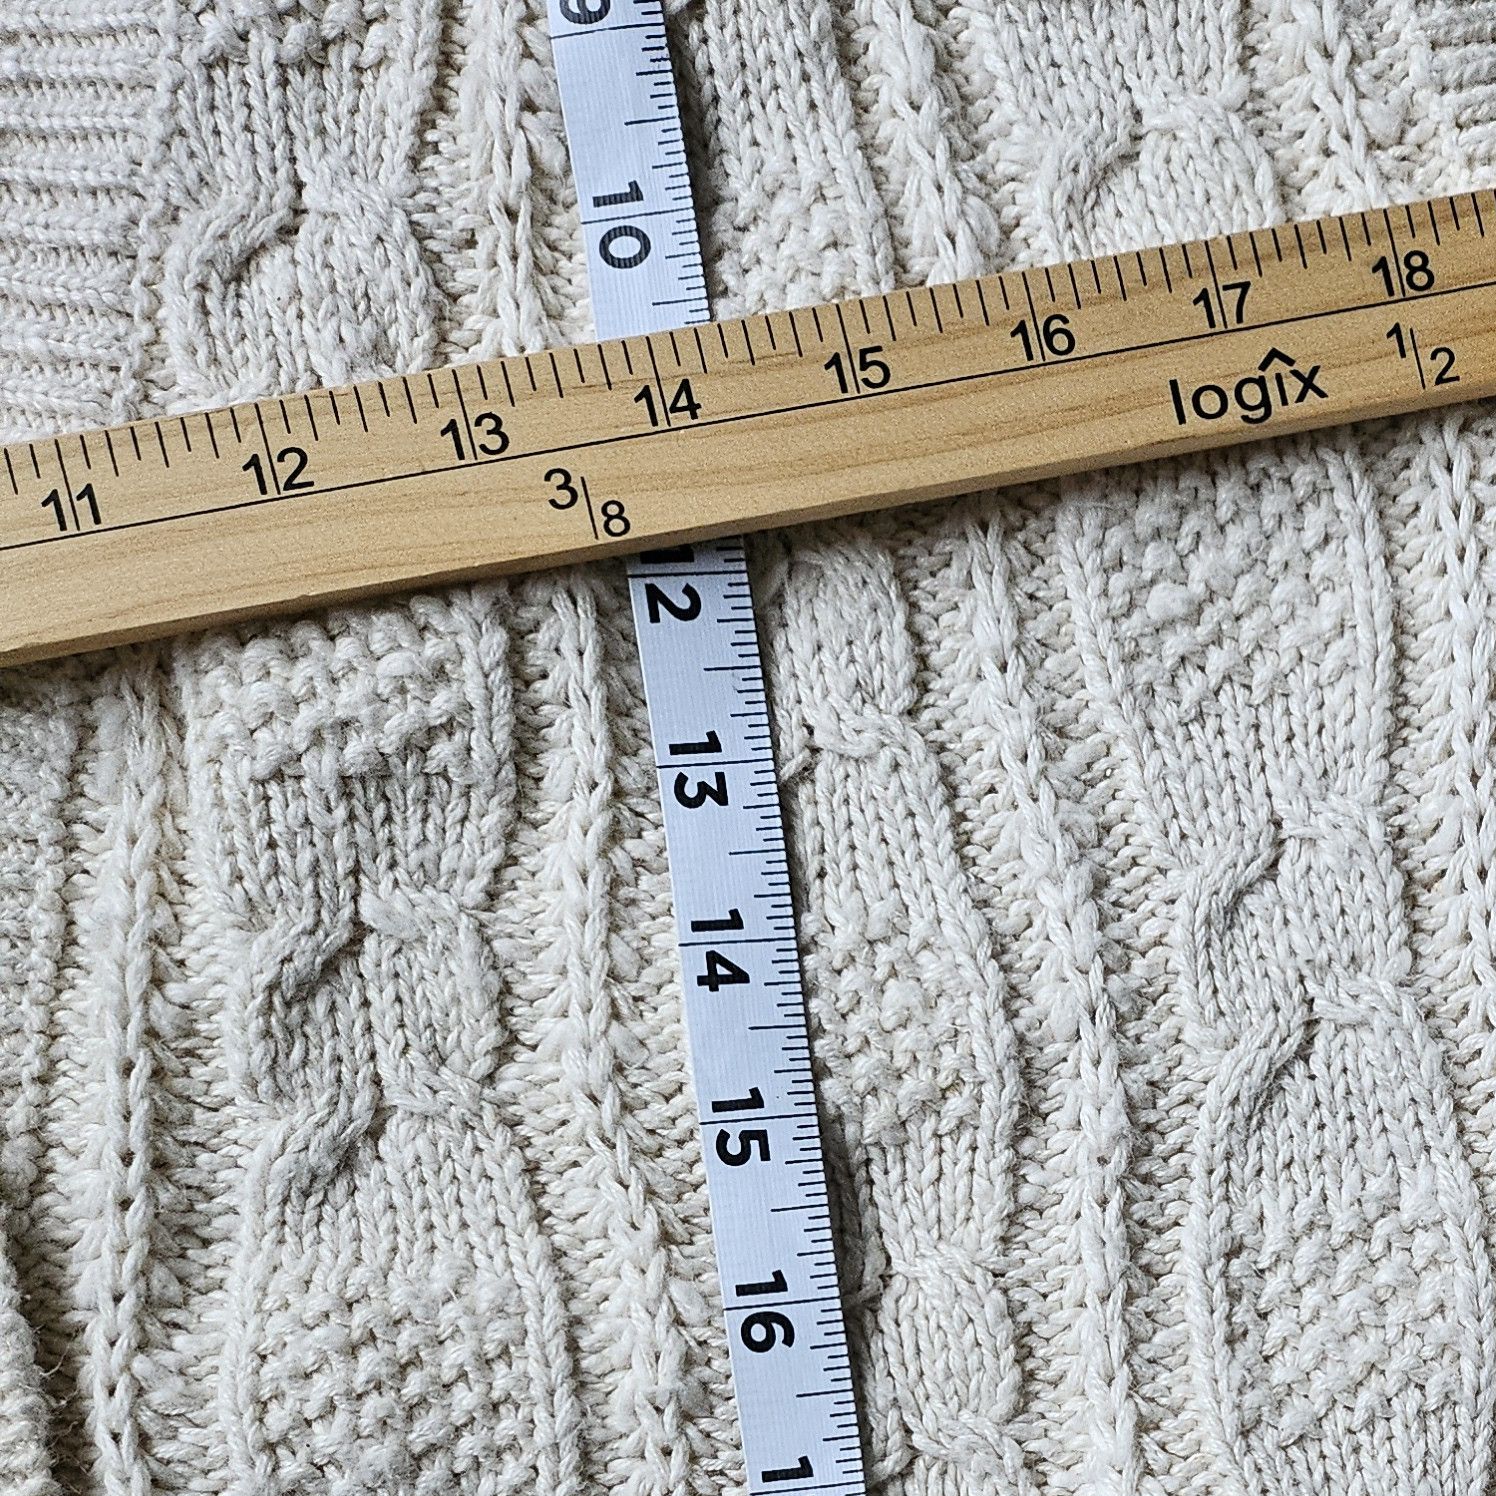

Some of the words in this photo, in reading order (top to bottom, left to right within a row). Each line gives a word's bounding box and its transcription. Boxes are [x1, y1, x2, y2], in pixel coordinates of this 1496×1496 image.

[593, 180, 651, 269] 10
[41, 483, 101, 531] 11
[242, 447, 314, 496] 12
[441, 412, 511, 461] 13
[634, 378, 701, 427] 14
[824, 346, 891, 394] 15
[1010, 314, 1076, 362] 16
[1192, 282, 1253, 330] 17
[1372, 250, 1435, 298] 18
[669, 730, 728, 809] 13
[690, 908, 750, 991] 14
[711, 1087, 771, 1167] 15
[735, 1269, 795, 1353] 16
